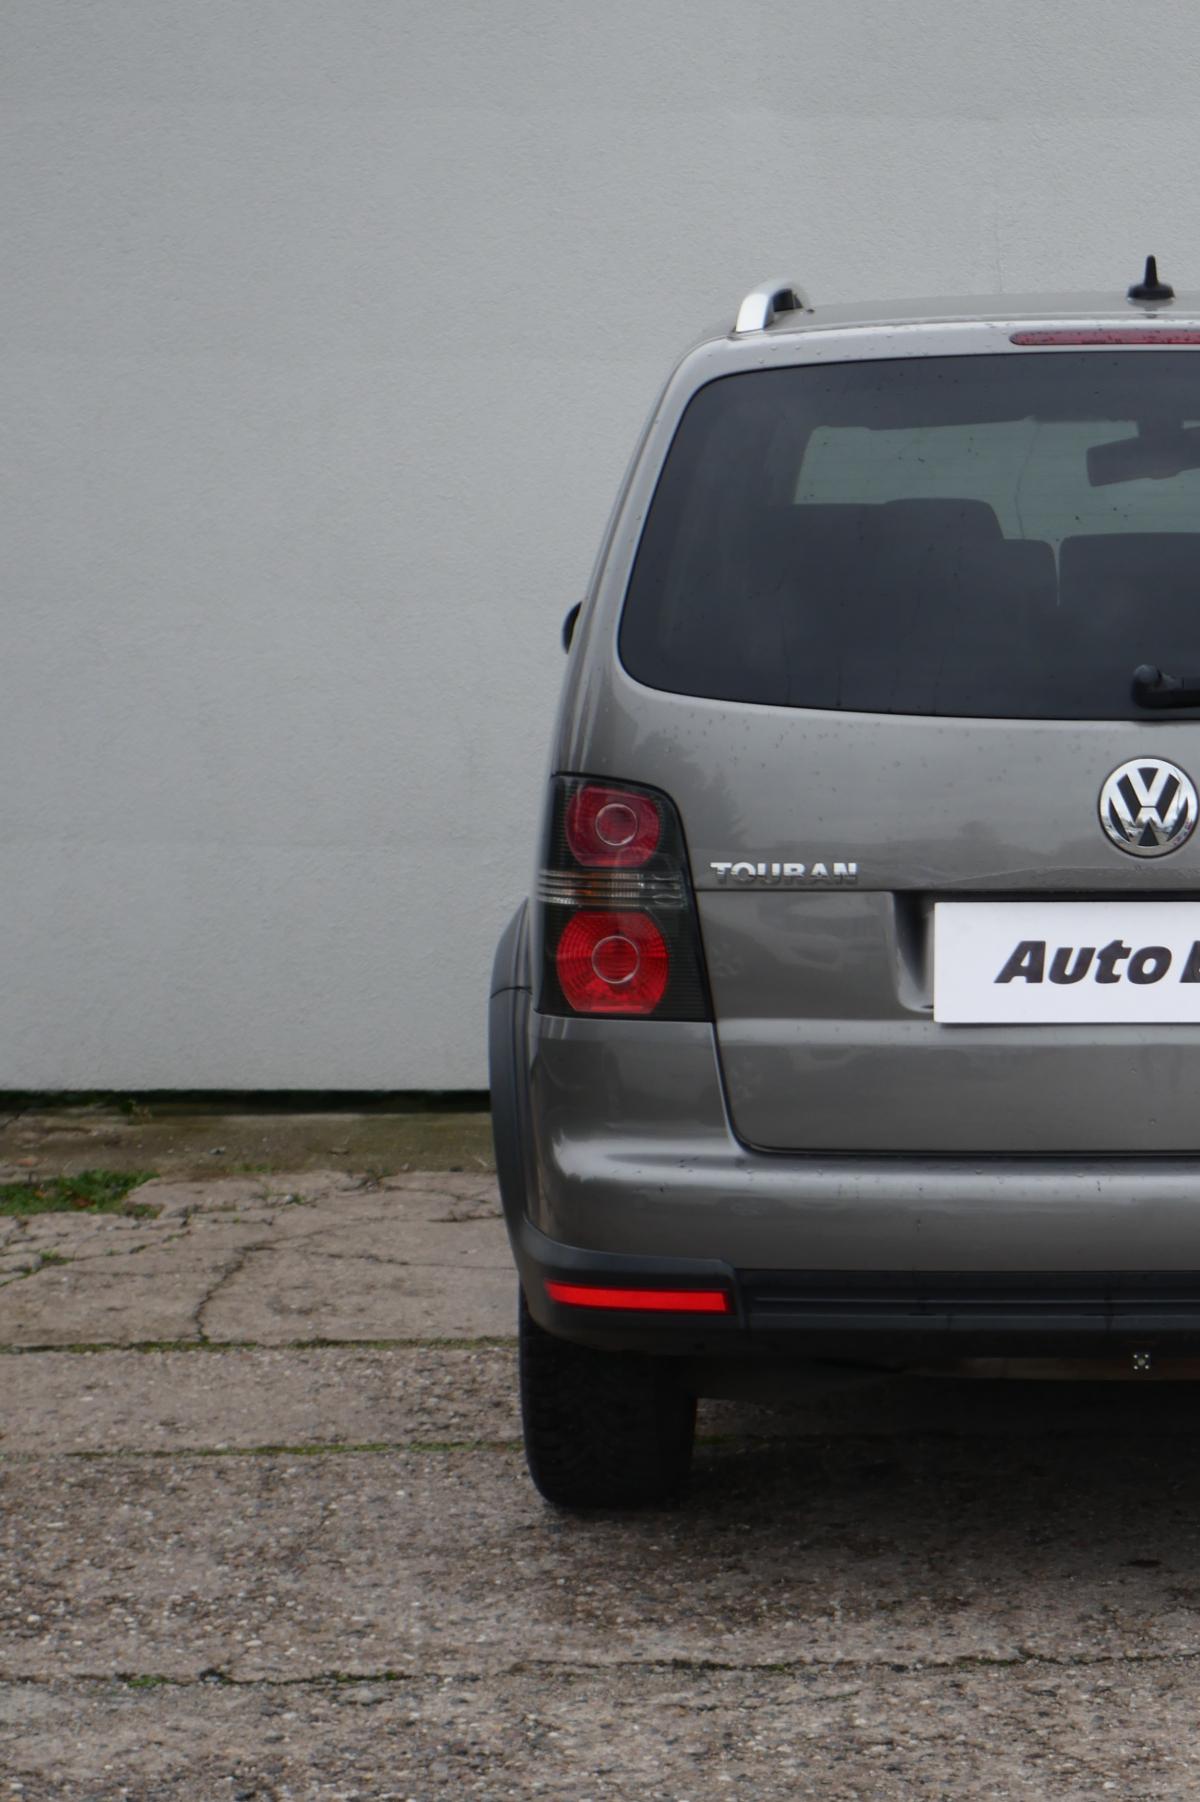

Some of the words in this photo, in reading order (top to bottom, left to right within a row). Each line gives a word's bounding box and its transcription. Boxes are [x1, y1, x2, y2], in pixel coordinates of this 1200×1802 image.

[1102, 760, 1198, 852] VW
[710, 861, 858, 884] TOURAN
[994, 939, 1173, 984] Auto
